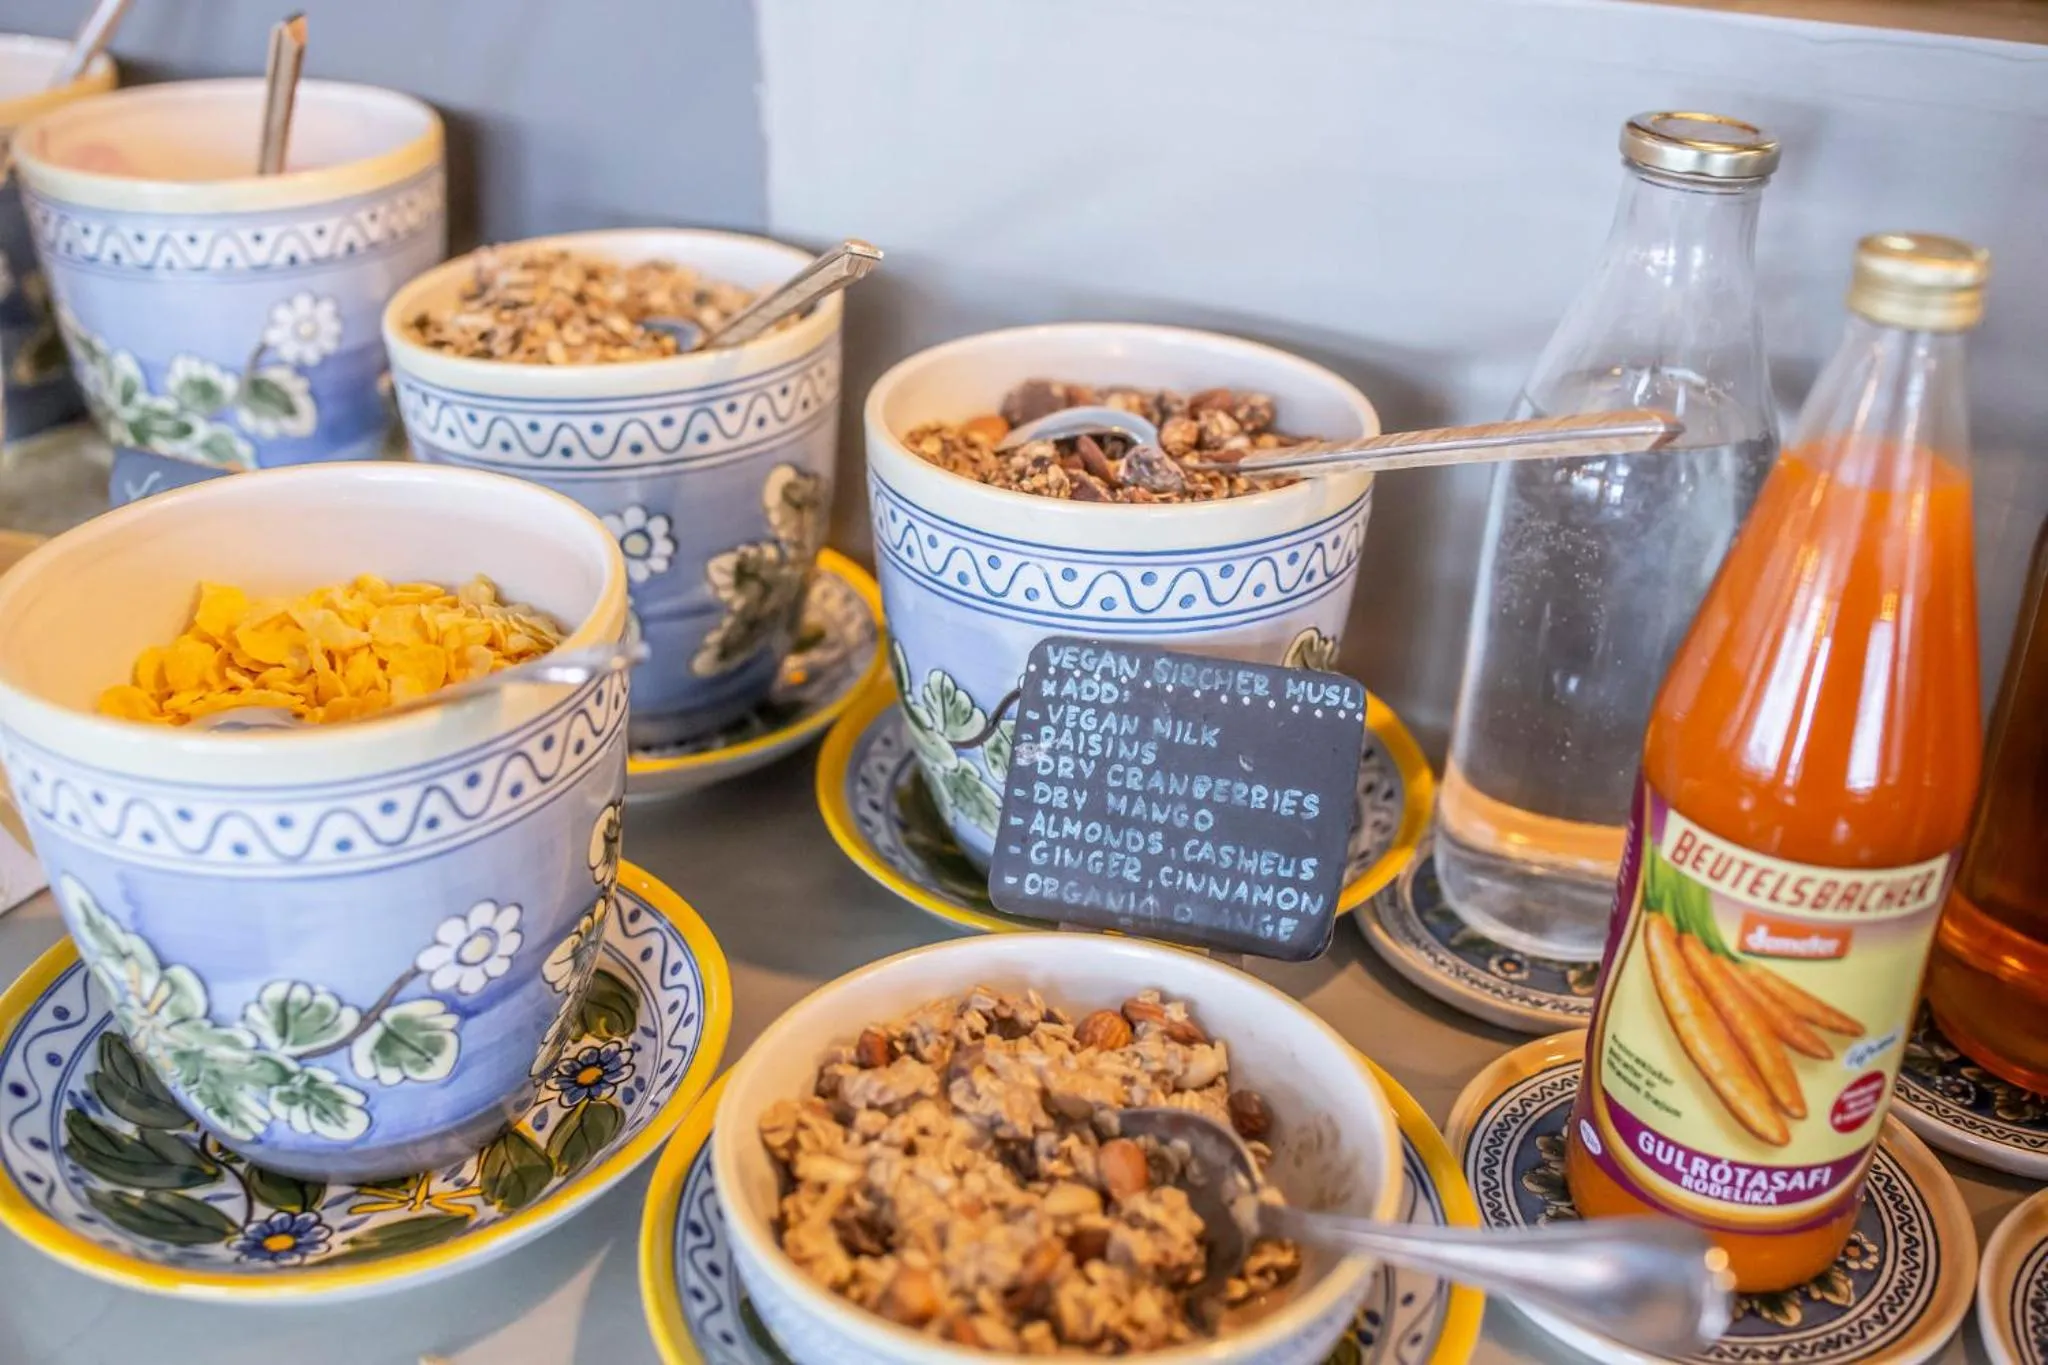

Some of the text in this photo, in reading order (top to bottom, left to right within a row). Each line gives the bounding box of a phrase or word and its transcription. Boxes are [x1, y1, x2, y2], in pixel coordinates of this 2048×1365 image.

[1047, 645, 1140, 679] VEGAN
[1047, 704, 1221, 748] VEGAN MILK
[1032, 782, 1214, 831] DRY MANGO
[1106, 763, 1321, 820] CRANBERRIES
[1159, 866, 1324, 916] CINNAMON
[1669, 828, 1940, 913] BEUTELSBACHER
[1637, 1130, 1833, 1193] GULRÓTASAFI
[1681, 1173, 1778, 1206] RODELIKA
